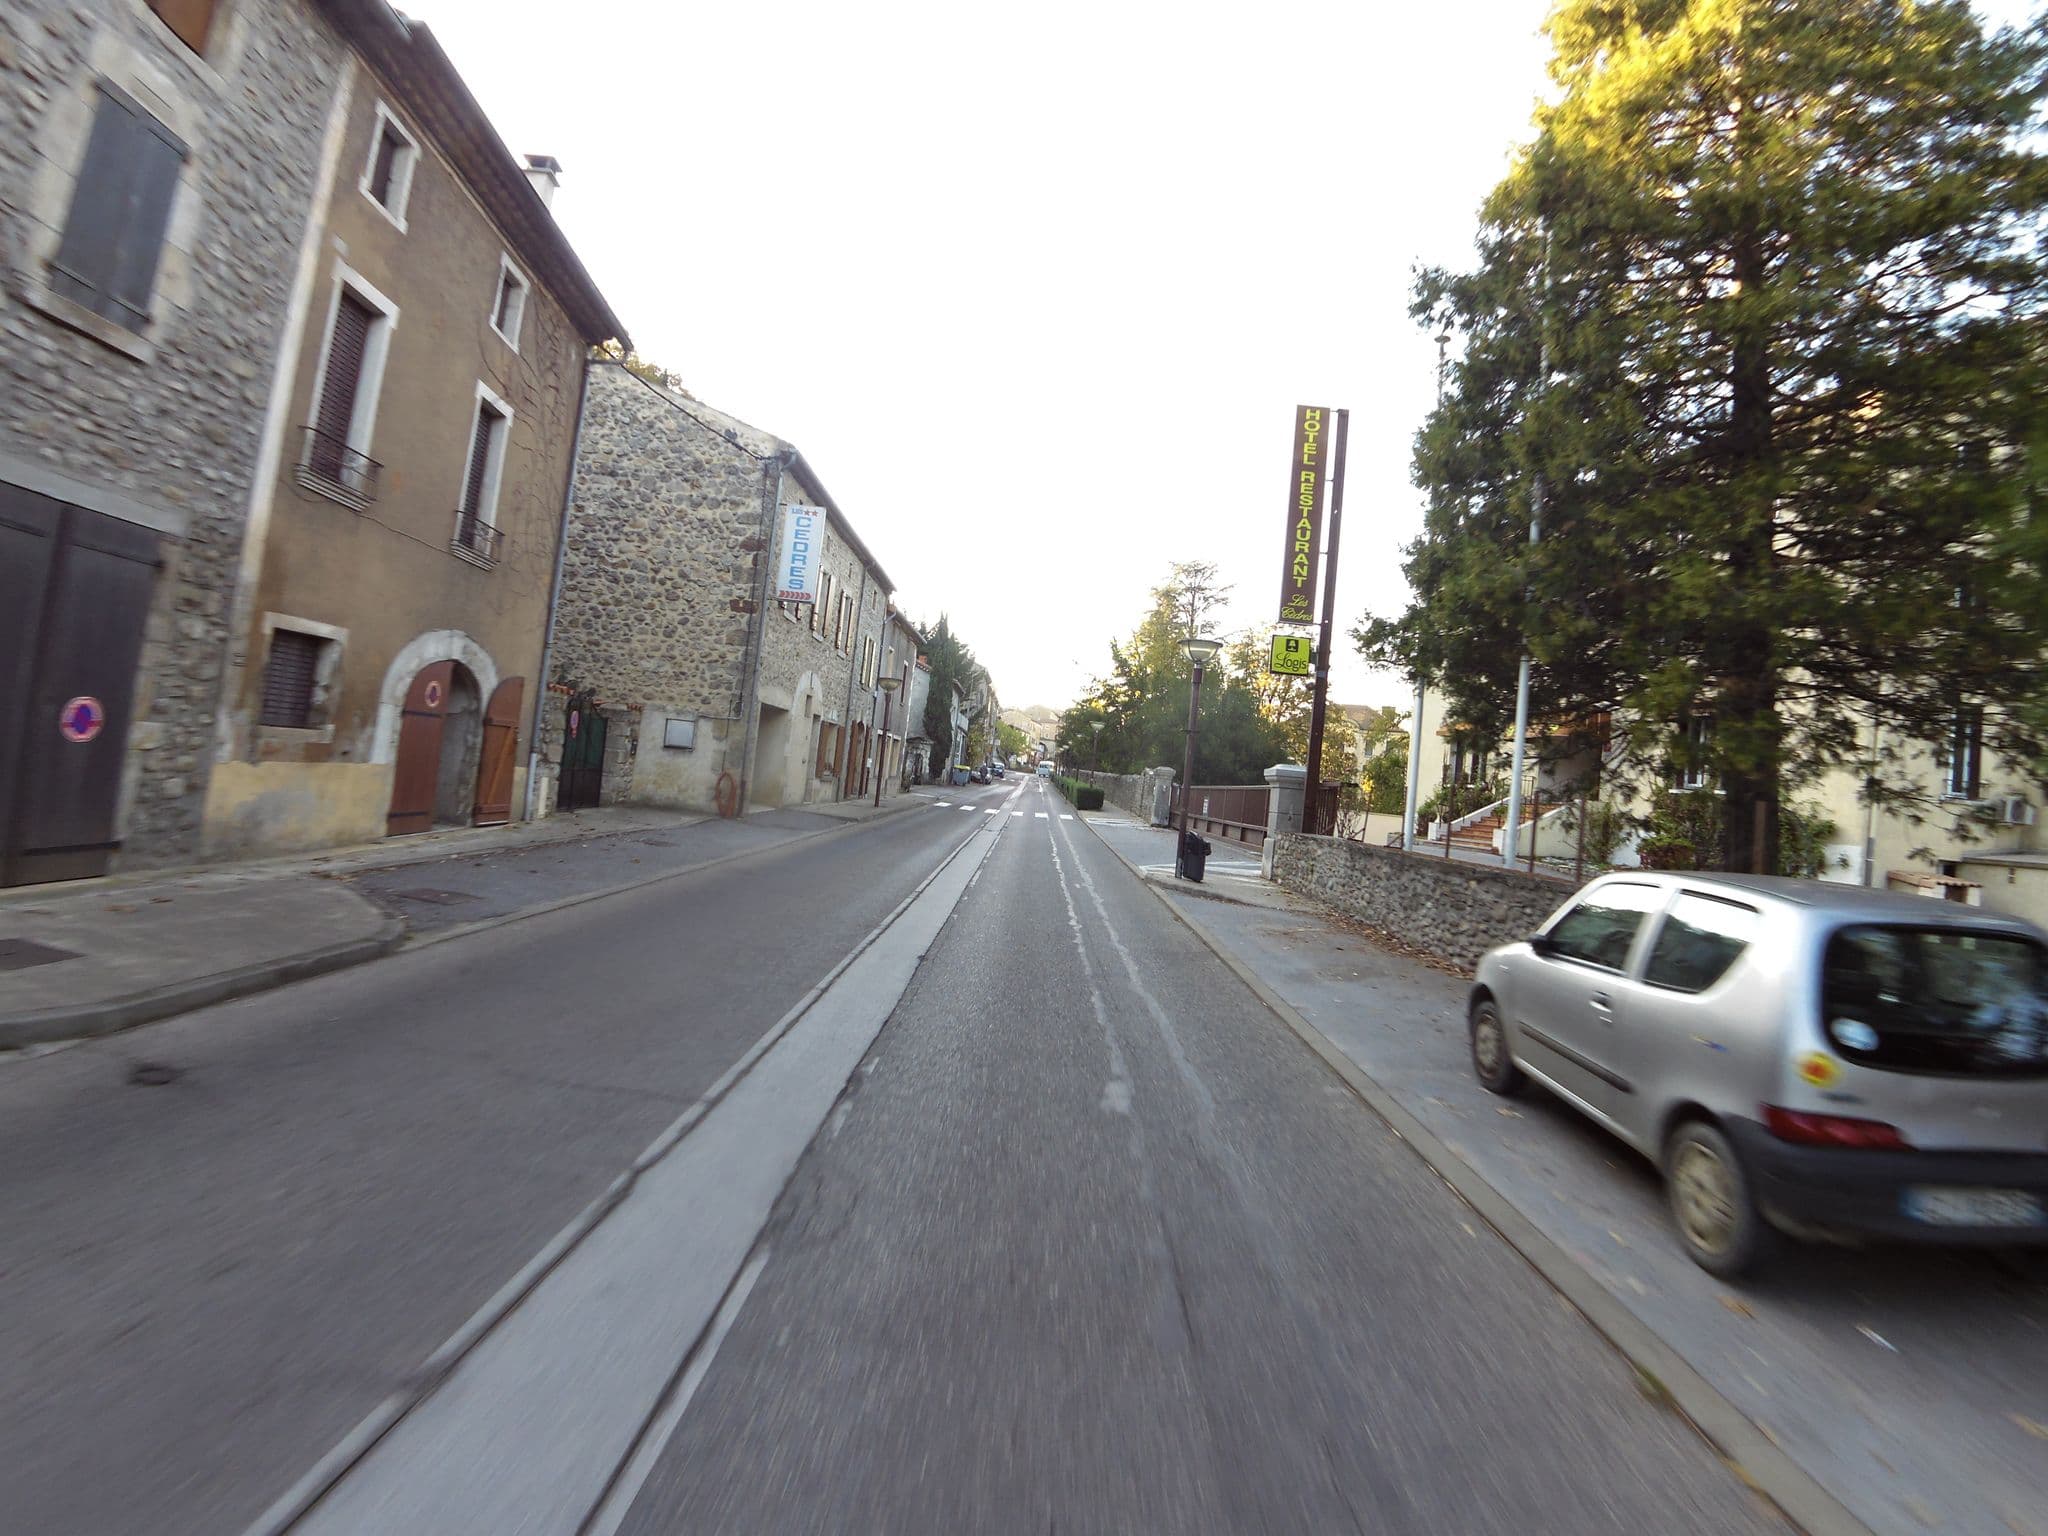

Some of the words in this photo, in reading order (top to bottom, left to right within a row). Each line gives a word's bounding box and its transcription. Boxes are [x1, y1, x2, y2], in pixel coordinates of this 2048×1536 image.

[1303, 408, 1321, 465] HOTEL
[788, 516, 812, 590] CEDRES
[1294, 471, 1315, 588] RESTAURANT
[1288, 594, 1308, 607] Les
[1274, 653, 1307, 672] Logis
